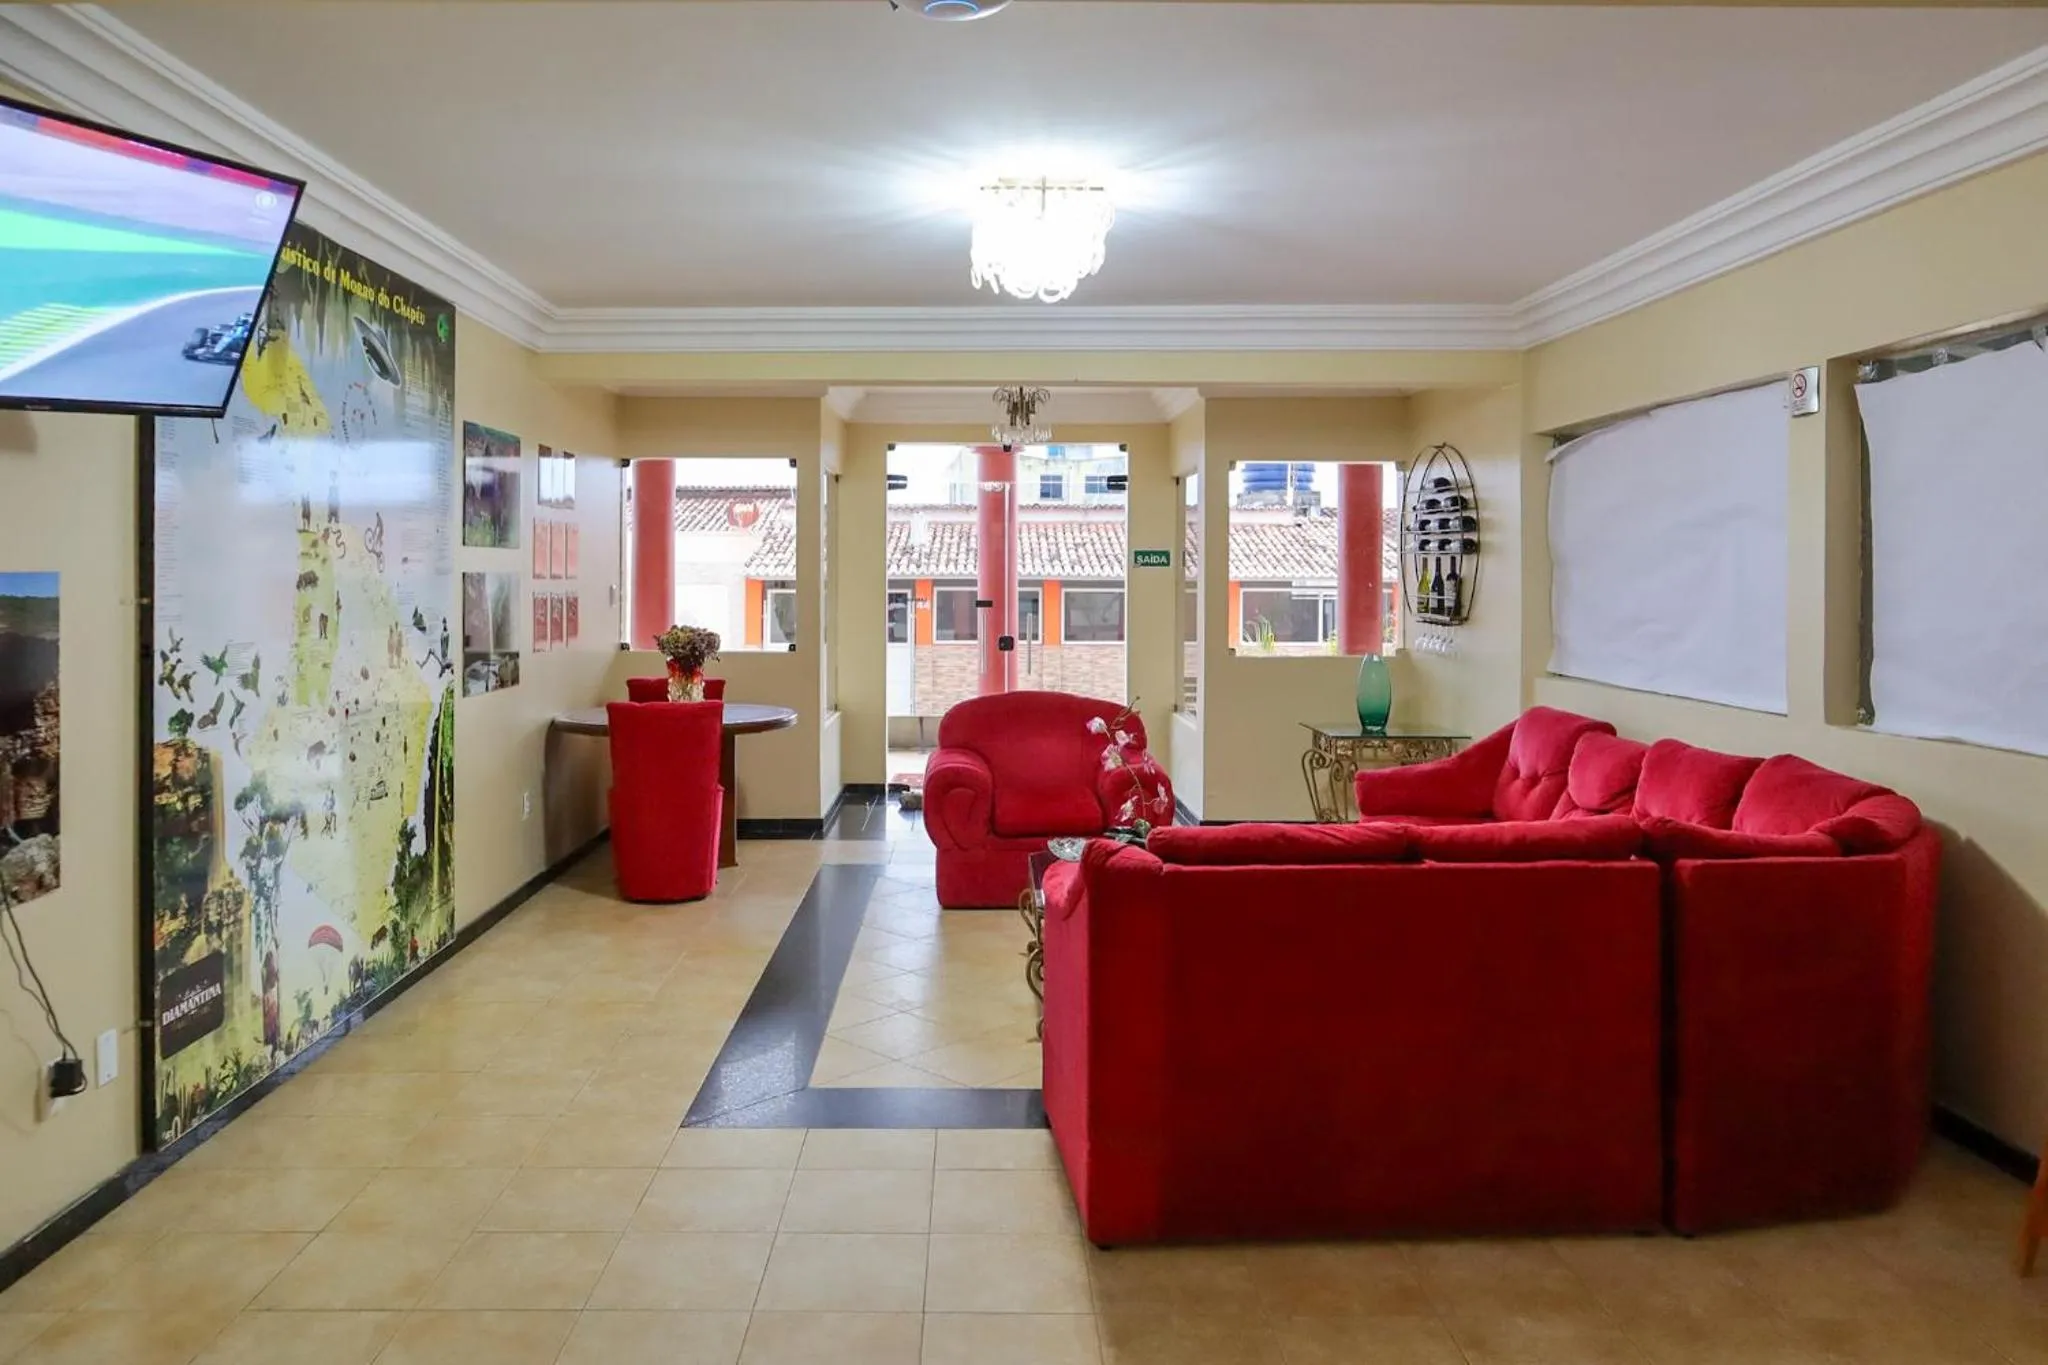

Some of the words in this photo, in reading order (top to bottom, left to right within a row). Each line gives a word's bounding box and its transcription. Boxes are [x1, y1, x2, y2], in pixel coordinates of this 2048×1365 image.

[377, 287, 390, 310] do
[1136, 553, 1168, 565] SAÍDA
[162, 982, 222, 1026] DIAMANTINA
